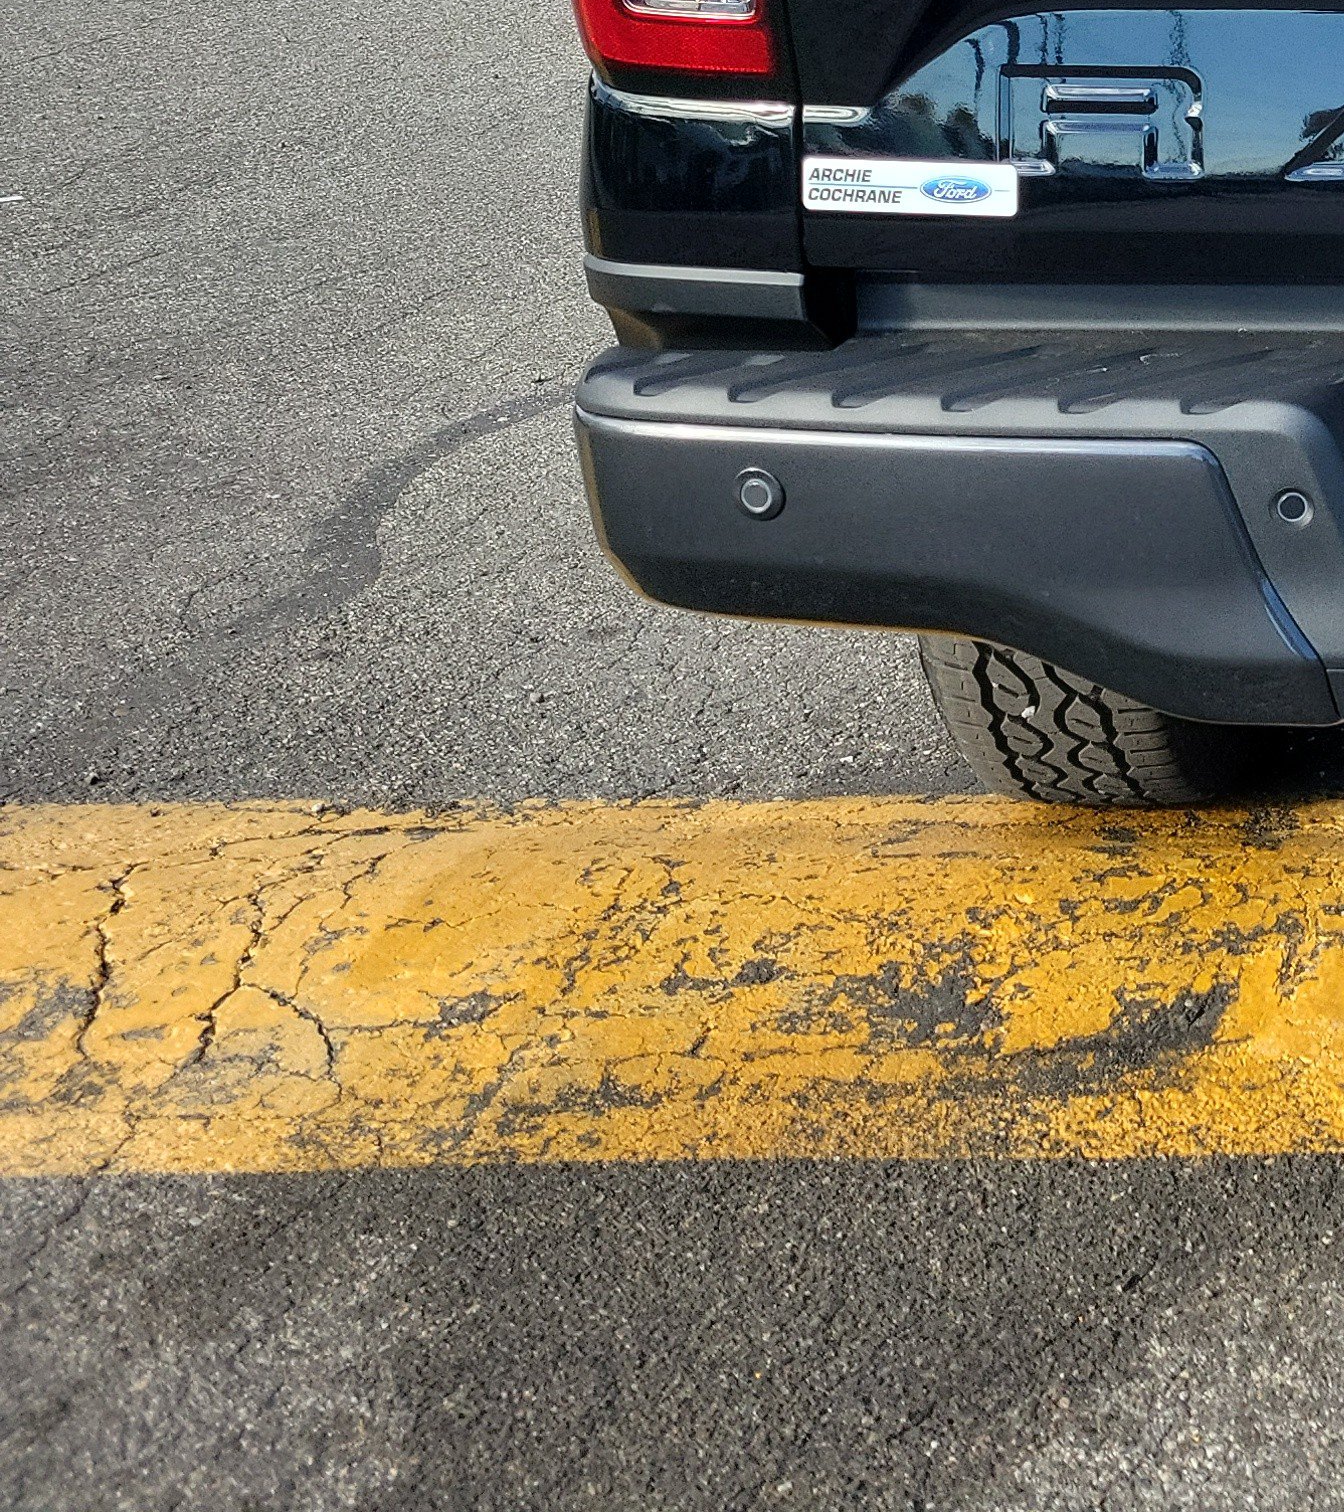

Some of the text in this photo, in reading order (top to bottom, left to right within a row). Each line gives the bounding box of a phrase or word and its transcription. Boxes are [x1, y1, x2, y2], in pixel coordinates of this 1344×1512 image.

[809, 167, 872, 183] ARCHIE
[808, 187, 902, 204] COCHRANE
[933, 180, 978, 200] Ford
